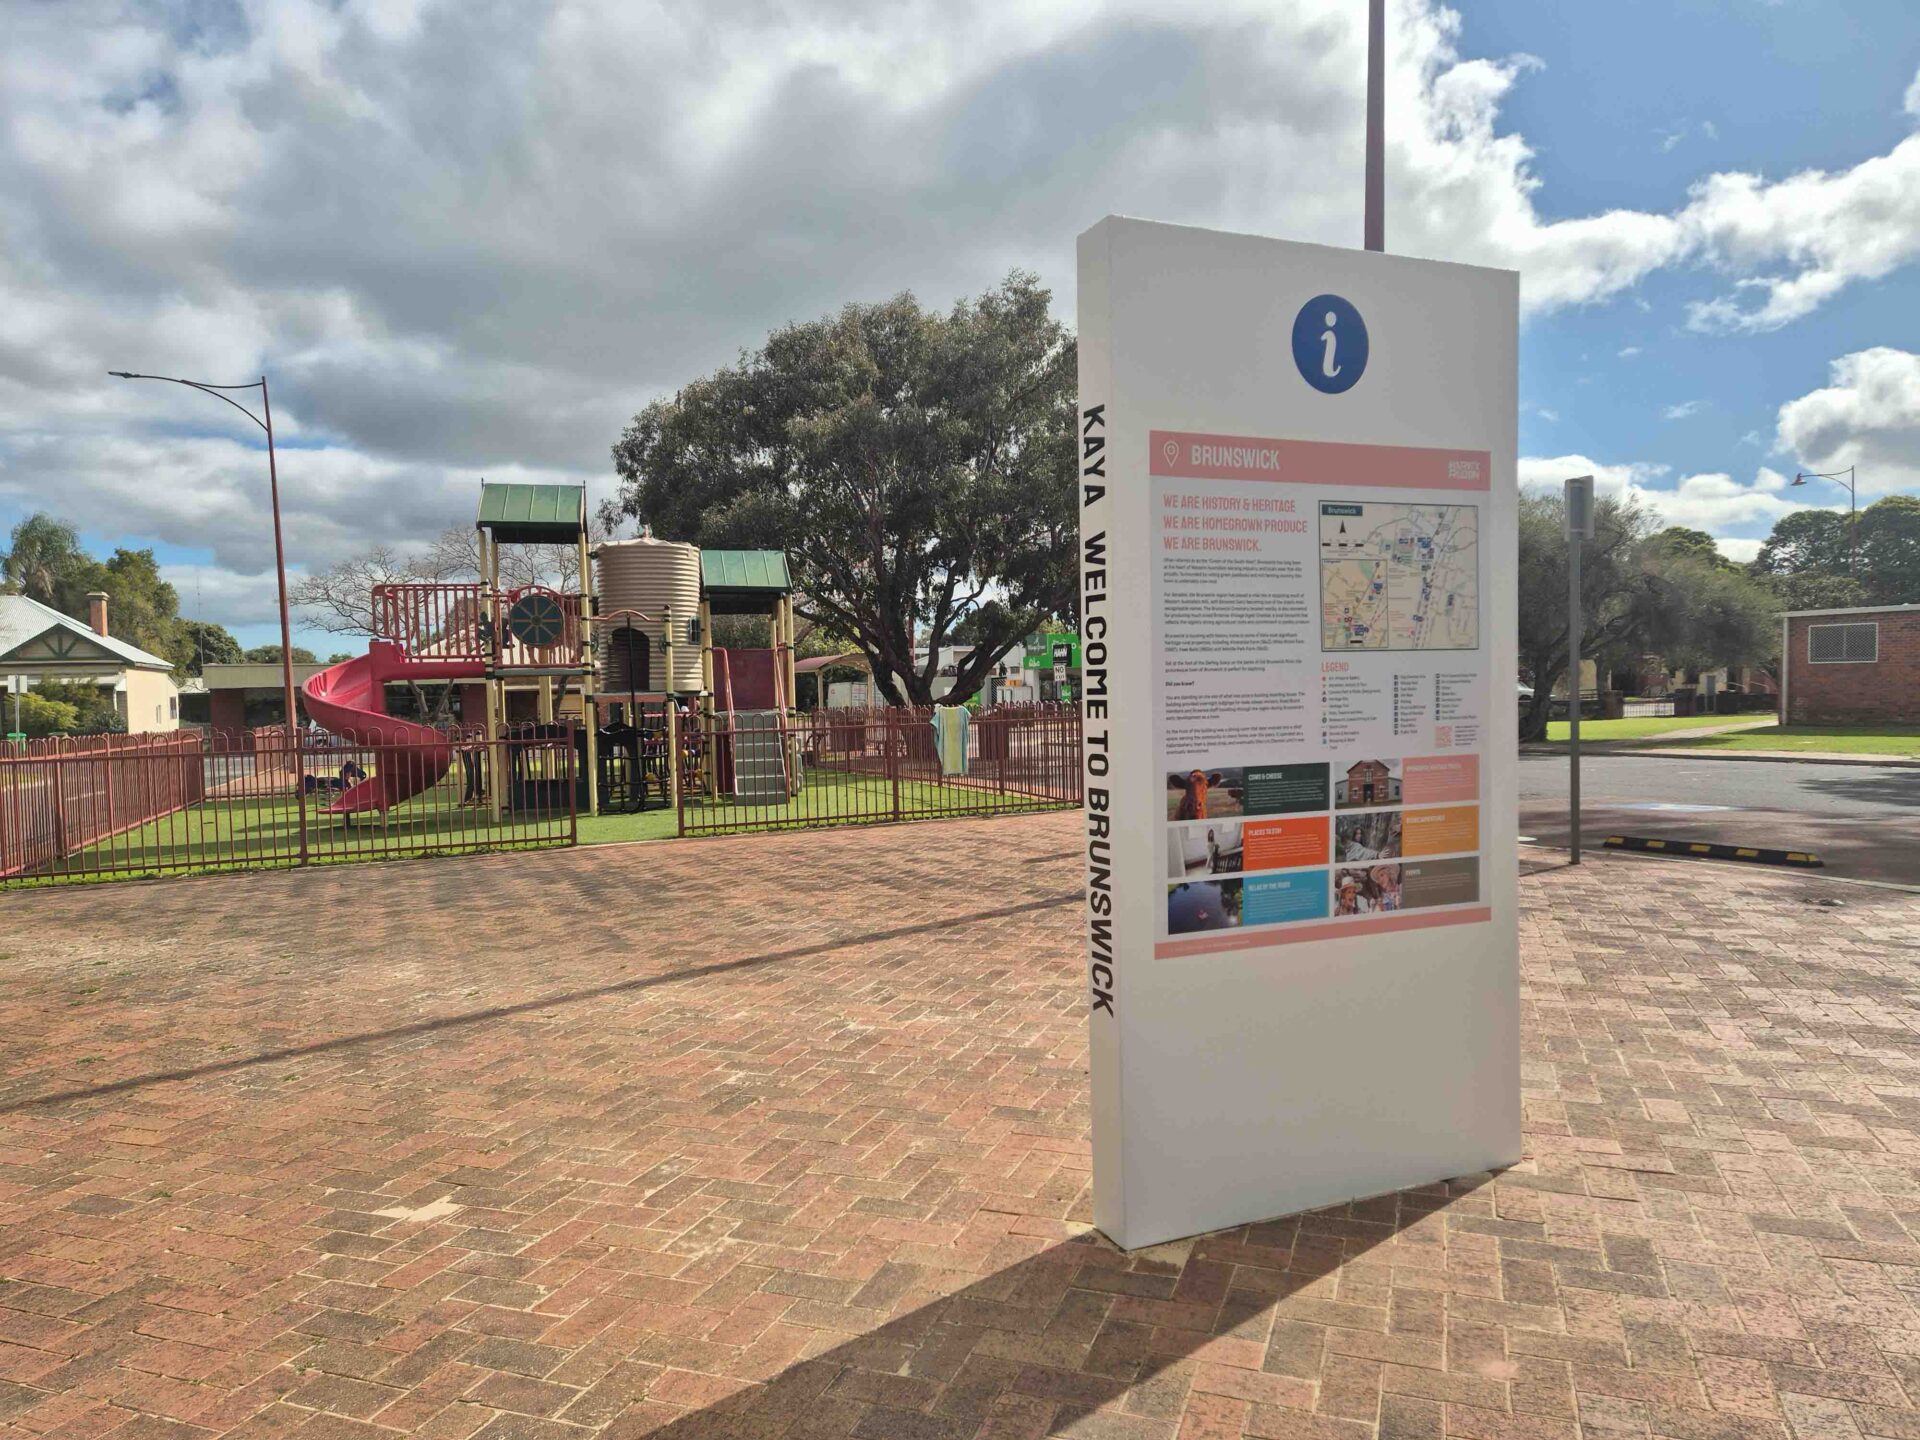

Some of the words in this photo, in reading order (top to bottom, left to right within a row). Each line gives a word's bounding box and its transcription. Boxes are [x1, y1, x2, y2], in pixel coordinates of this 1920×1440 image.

[1083, 404, 1106, 508] KAYA
[1191, 445, 1280, 470] BRUNSWICK
[1164, 494, 1178, 509] WE
[1181, 495, 1200, 509] ARE
[1202, 496, 1241, 511] HISTORY
[1242, 498, 1251, 511] &
[1252, 499, 1296, 513] HERITAGE
[1164, 515, 1178, 529] WE
[1181, 516, 1200, 530] ARE
[1202, 516, 1263, 531] HOMEGROWN
[1264, 519, 1308, 533] PRODUCE
[1164, 536, 1178, 550] WE
[1181, 537, 1200, 550] ARE
[1202, 537, 1262, 552] BRUNSWICK.
[1085, 530, 1108, 720] WELCOME
[1055, 666, 1065, 674] NO
[1321, 662, 1349, 673] LEGEND
[1087, 730, 1110, 777] TO
[1088, 787, 1114, 1018] BRUNSWICK
